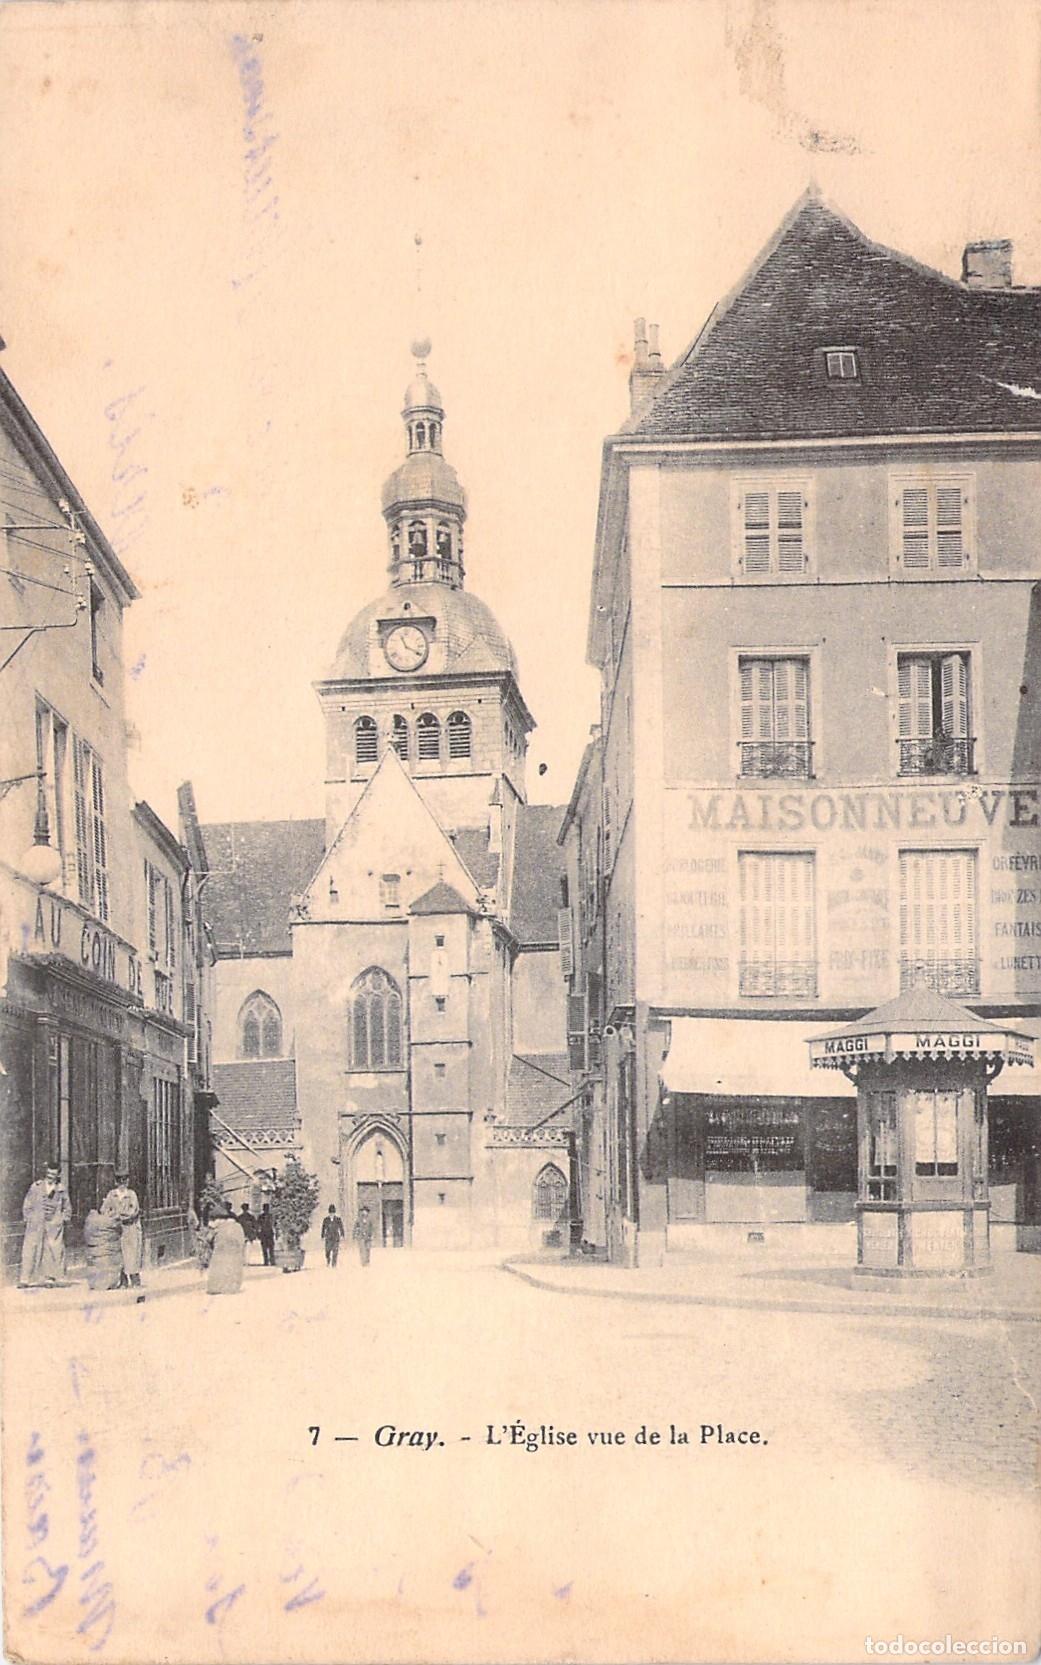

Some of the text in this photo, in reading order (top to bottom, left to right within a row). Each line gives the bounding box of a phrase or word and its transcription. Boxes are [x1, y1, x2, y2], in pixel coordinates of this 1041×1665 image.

[687, 789, 1039, 833] MAISONNEUVE
[992, 852, 1041, 872] ORFÈVR
[34, 897, 61, 948] AU
[825, 1038, 869, 1054] MAGGI
[916, 1034, 981, 1048] MAGGI
